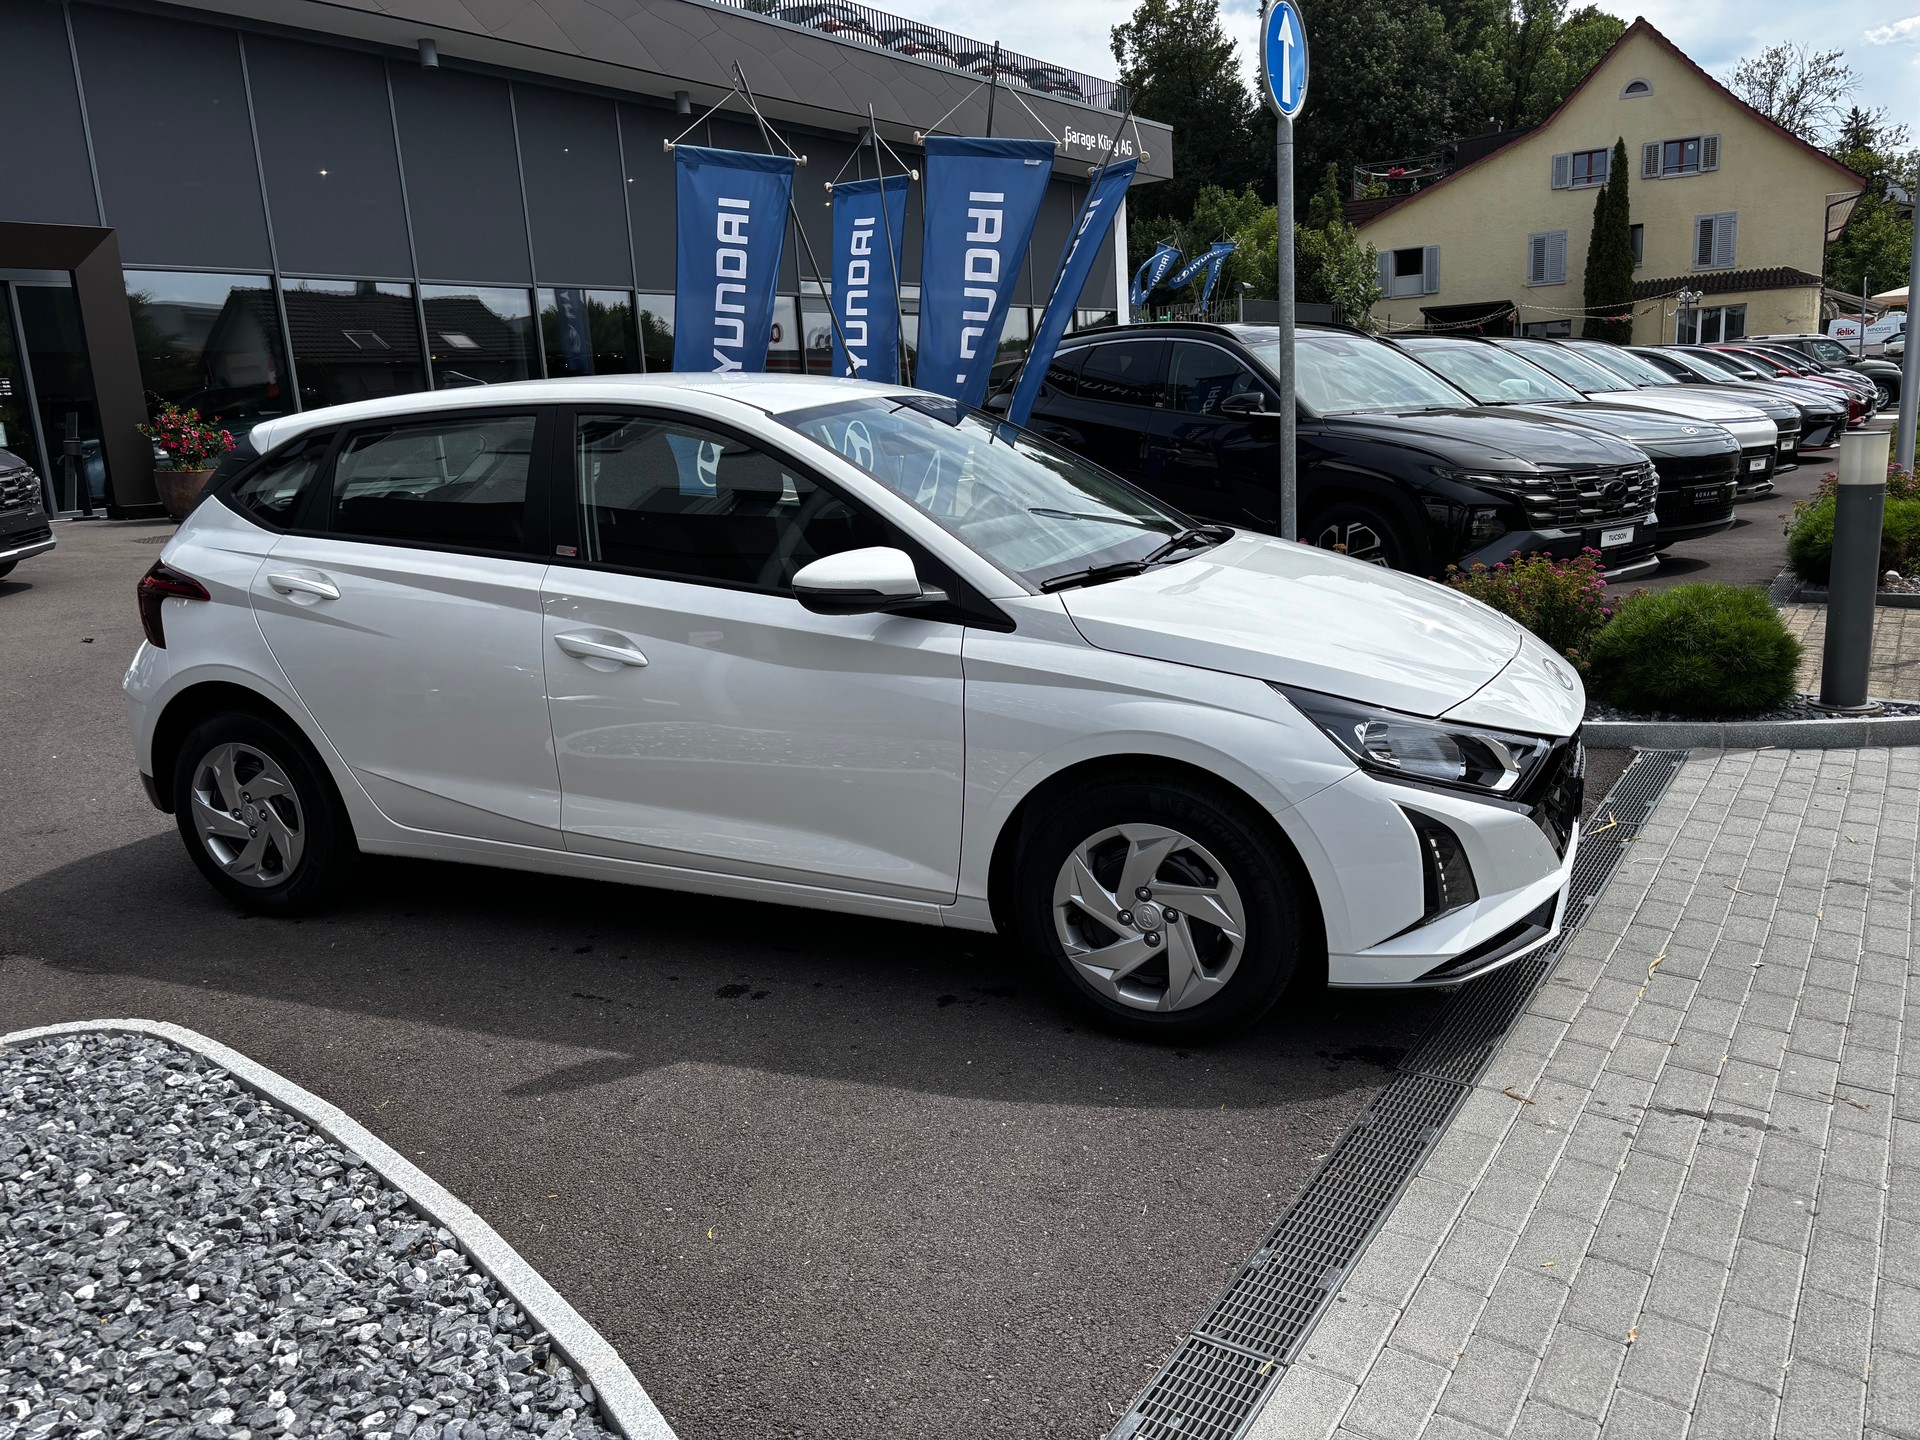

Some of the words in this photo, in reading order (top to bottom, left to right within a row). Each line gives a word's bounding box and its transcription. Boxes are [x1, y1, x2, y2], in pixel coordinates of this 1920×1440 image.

[1065, 126, 1096, 150] Garage
[1121, 139, 1132, 155] AG
[712, 197, 750, 373] YUNDAI
[846, 217, 875, 376] YUNDAI
[1836, 327, 1855, 336] felix
[1608, 532, 1628, 542] TUCSON
